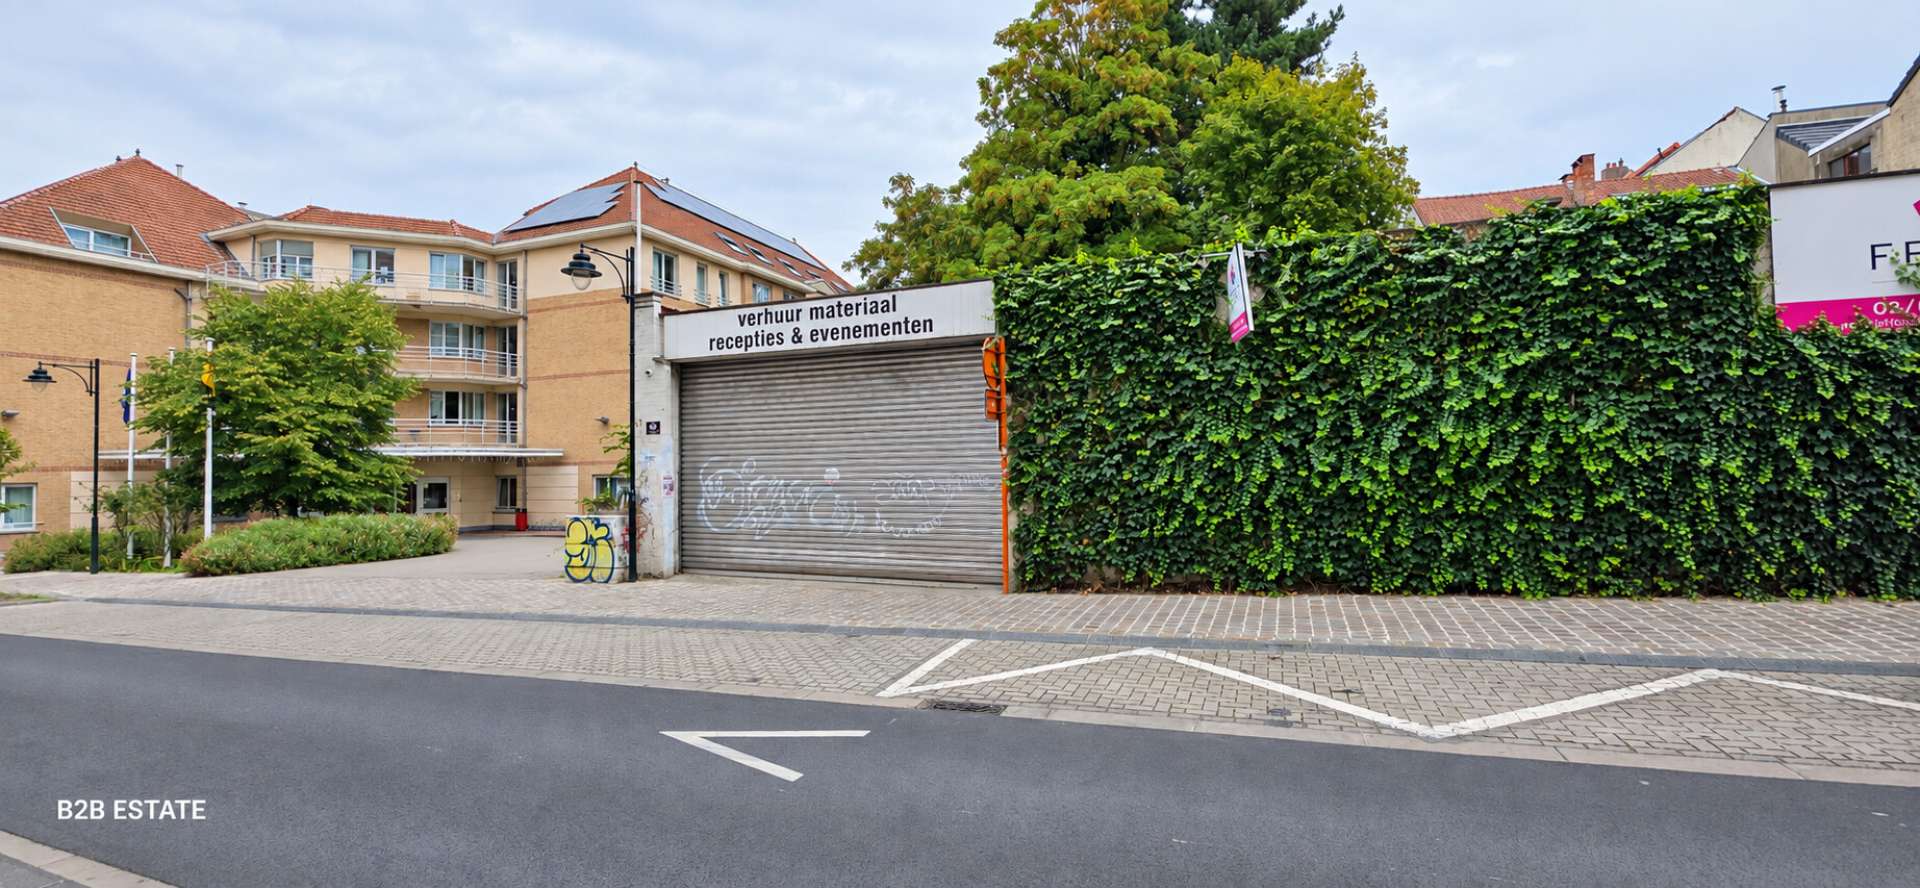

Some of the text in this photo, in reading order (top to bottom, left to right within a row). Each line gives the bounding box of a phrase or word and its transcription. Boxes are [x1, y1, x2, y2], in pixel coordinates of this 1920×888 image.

[737, 294, 897, 327] verhuur materiaal
[709, 316, 934, 352] recepties & evenementen
